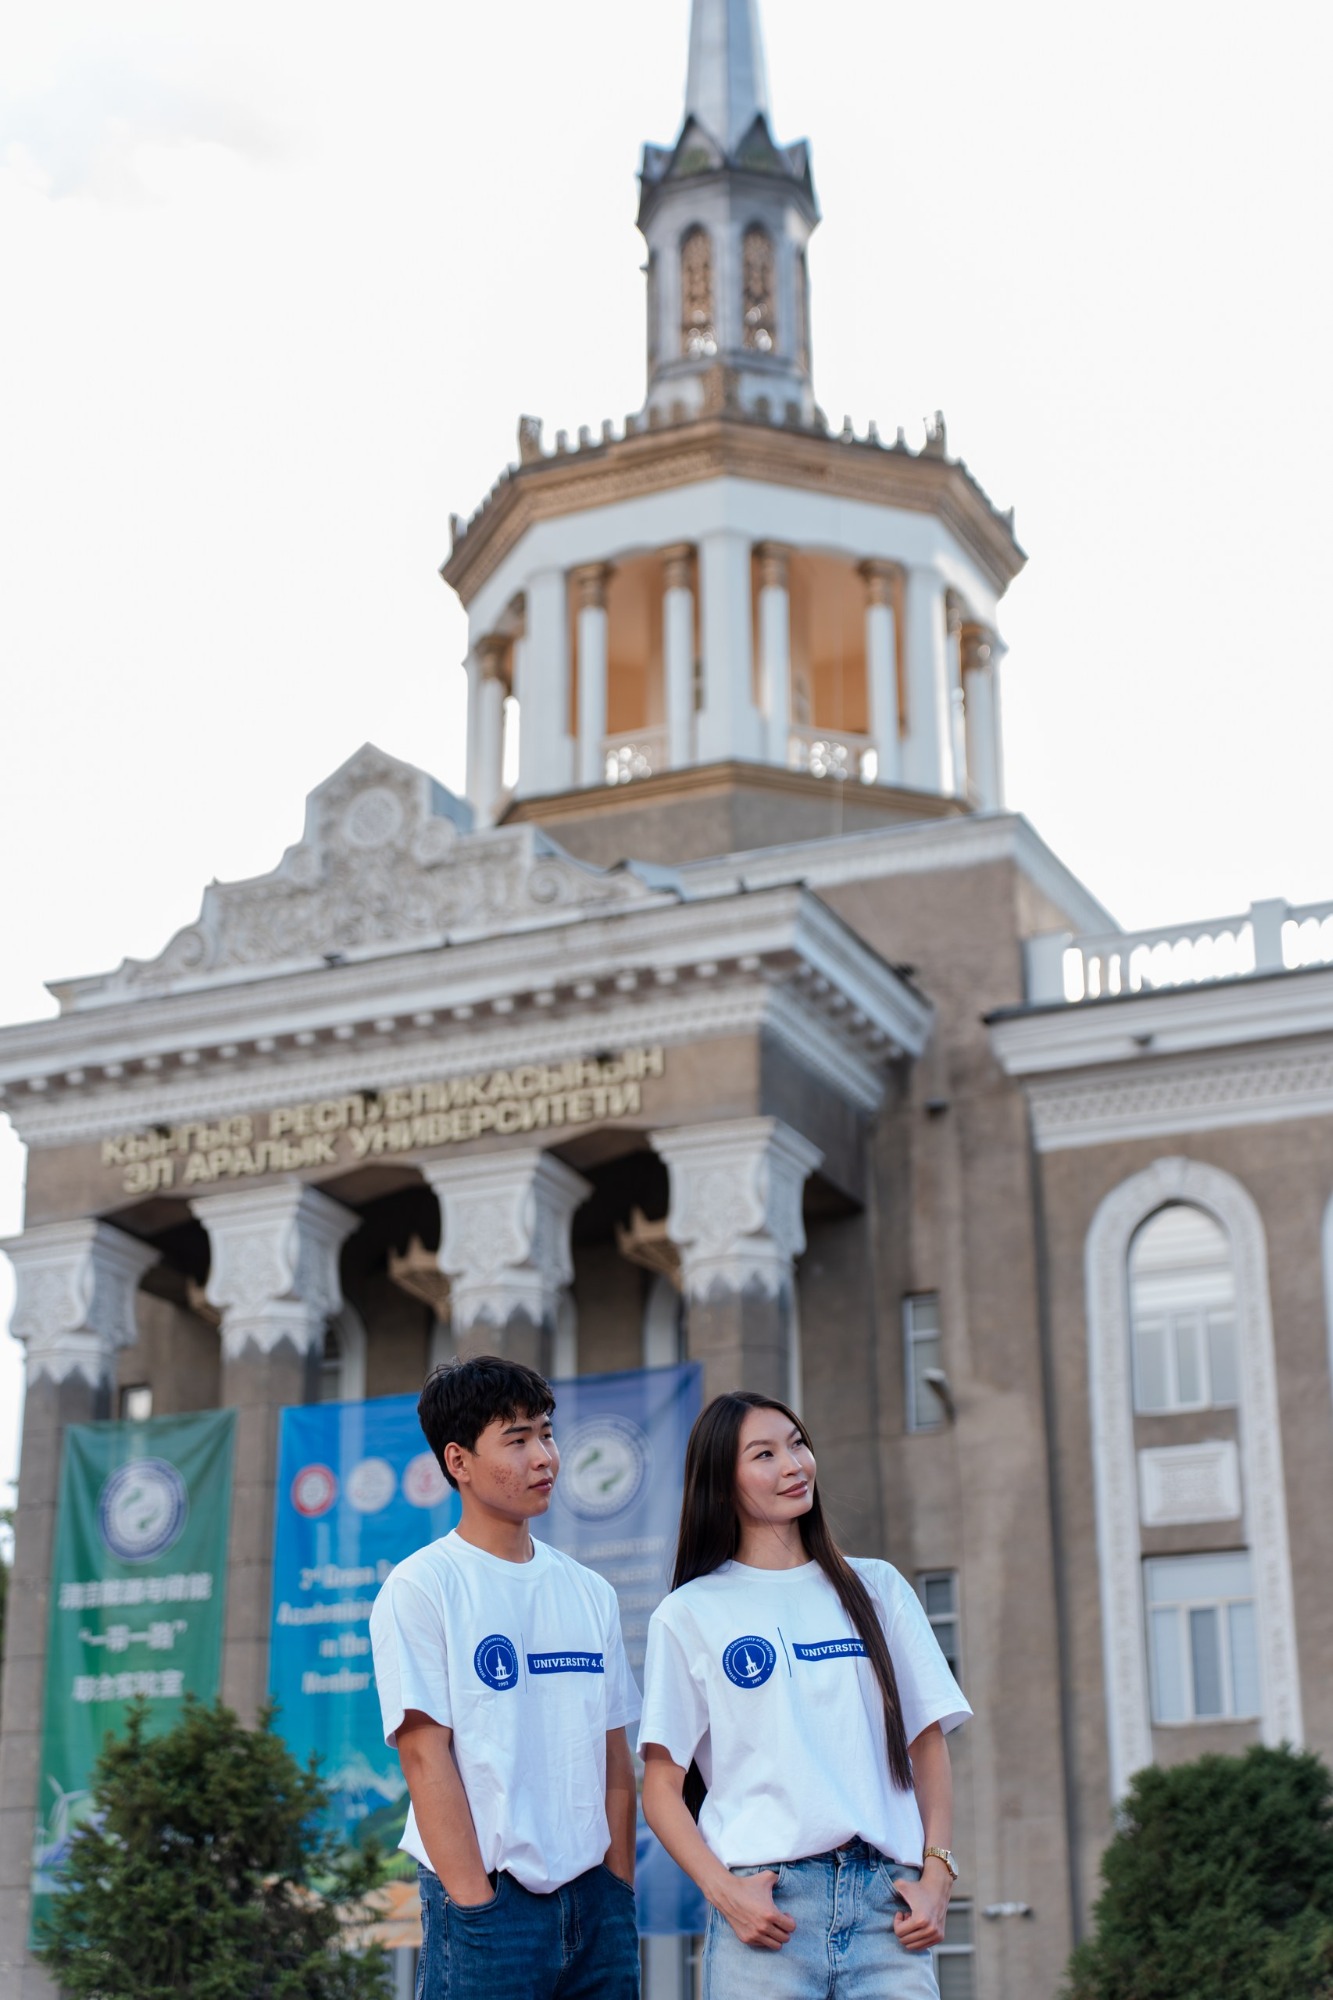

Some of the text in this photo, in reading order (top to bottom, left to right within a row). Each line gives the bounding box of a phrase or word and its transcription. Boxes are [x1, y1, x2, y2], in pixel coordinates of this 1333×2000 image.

[122, 1081, 641, 1194] ЭЛ АРАЛЫК УНИВЕРСИТЕТИ
[730, 1637, 756, 1648] University
[801, 1643, 864, 1657] UNIVERSITY
[533, 1657, 589, 1669] UNIVERSITY
[725, 1648, 737, 1681] International
